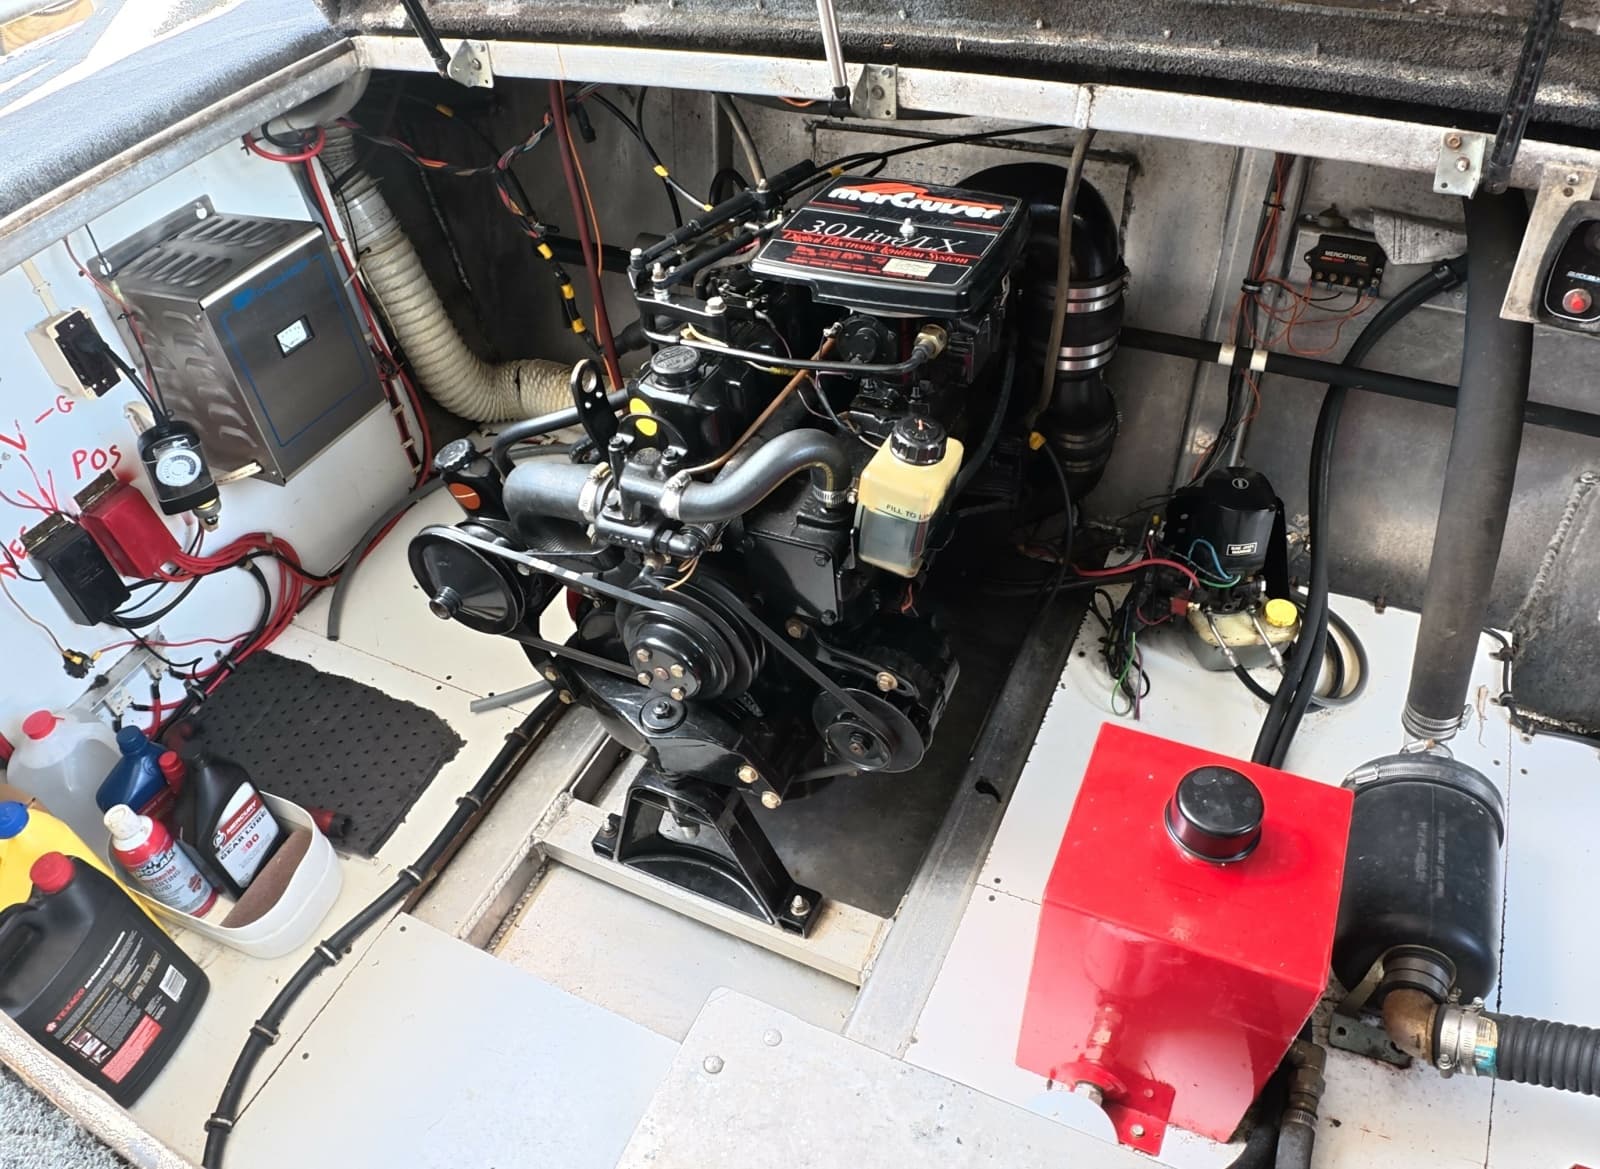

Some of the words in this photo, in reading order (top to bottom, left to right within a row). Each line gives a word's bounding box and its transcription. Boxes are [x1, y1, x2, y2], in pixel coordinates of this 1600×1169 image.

[782, 230, 821, 246] Digital
[822, 235, 877, 252] Electronic
[879, 245, 925, 260] Ignition
[926, 250, 970, 265] System
[1324, 249, 1368, 263] MERCATHODE
[71, 444, 122, 480] POS
[886, 504, 903, 515] FILL
[905, 510, 917, 520] TO
[225, 800, 257, 834] MERCURY
[220, 836, 244, 860] GEAR
[245, 810, 267, 834] LUBE
[54, 986, 85, 1022] TEXACO
